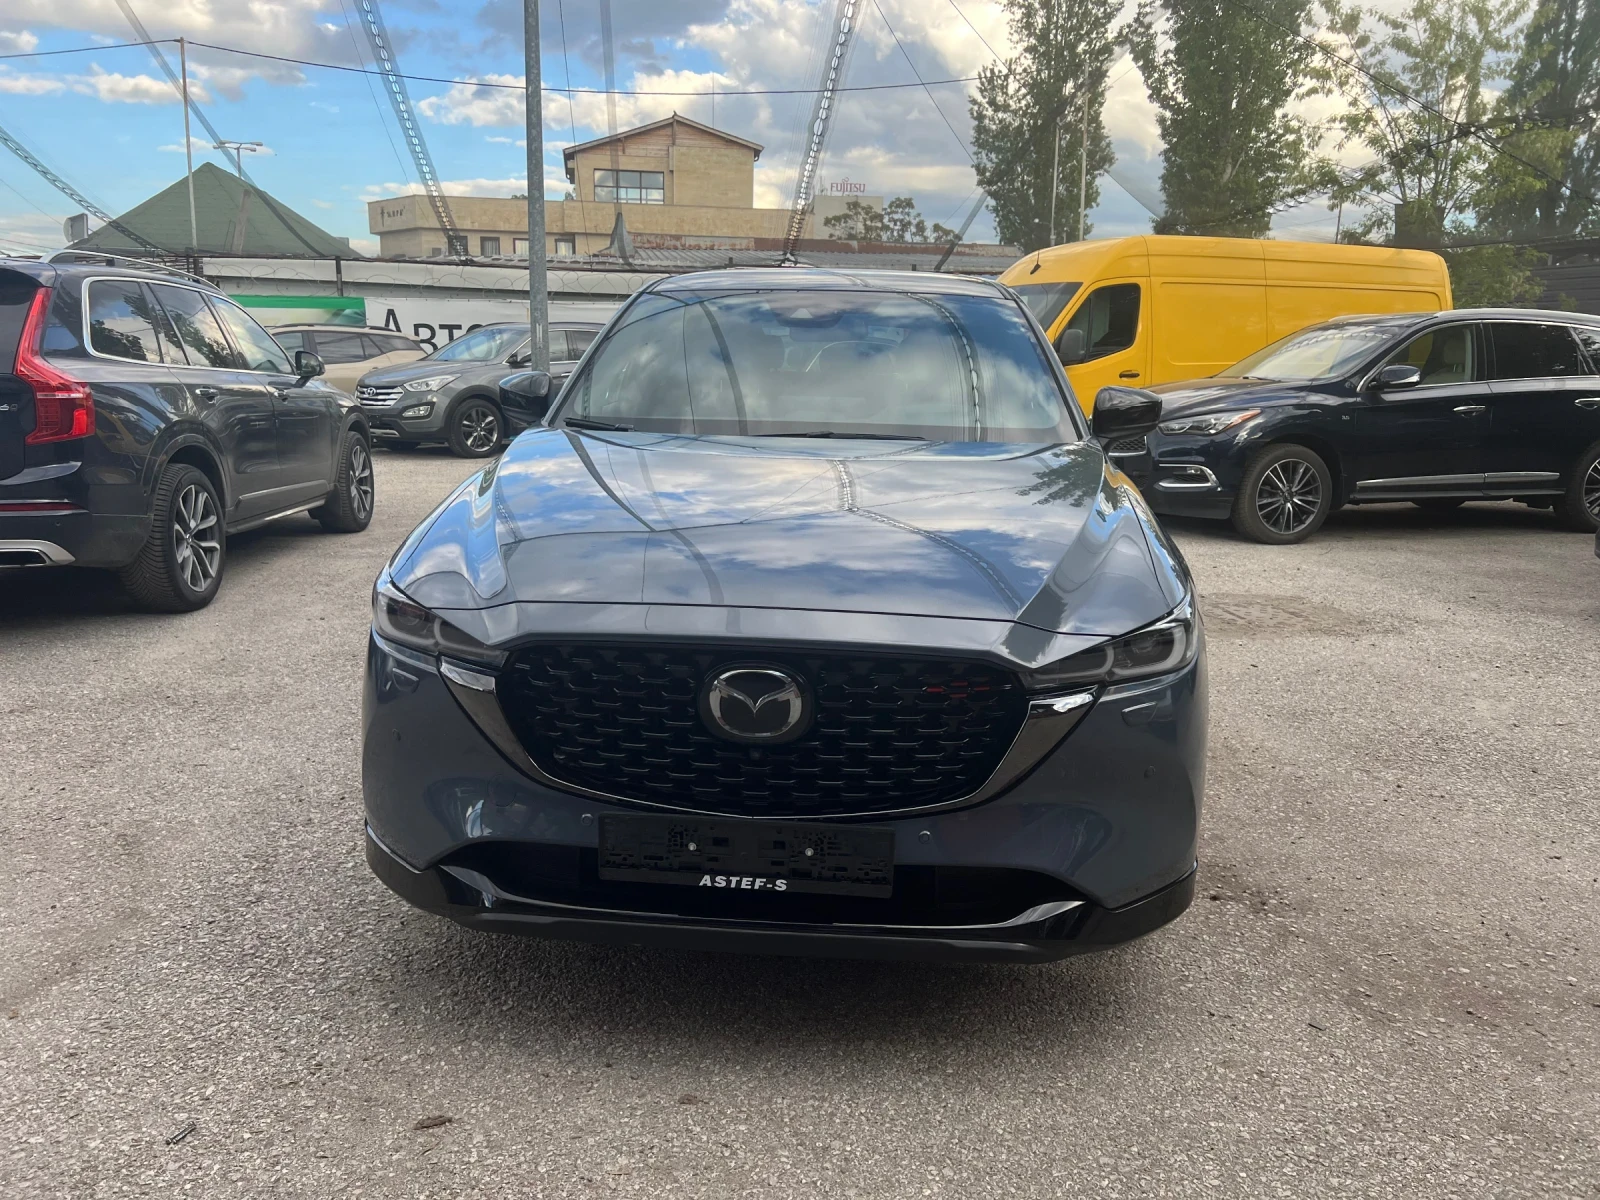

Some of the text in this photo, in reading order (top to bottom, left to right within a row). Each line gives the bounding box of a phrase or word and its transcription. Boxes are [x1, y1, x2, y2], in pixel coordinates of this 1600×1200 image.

[830, 179, 866, 194] FUJITSU
[384, 308, 484, 350] Авт
[699, 874, 788, 891] ASTEF-S
